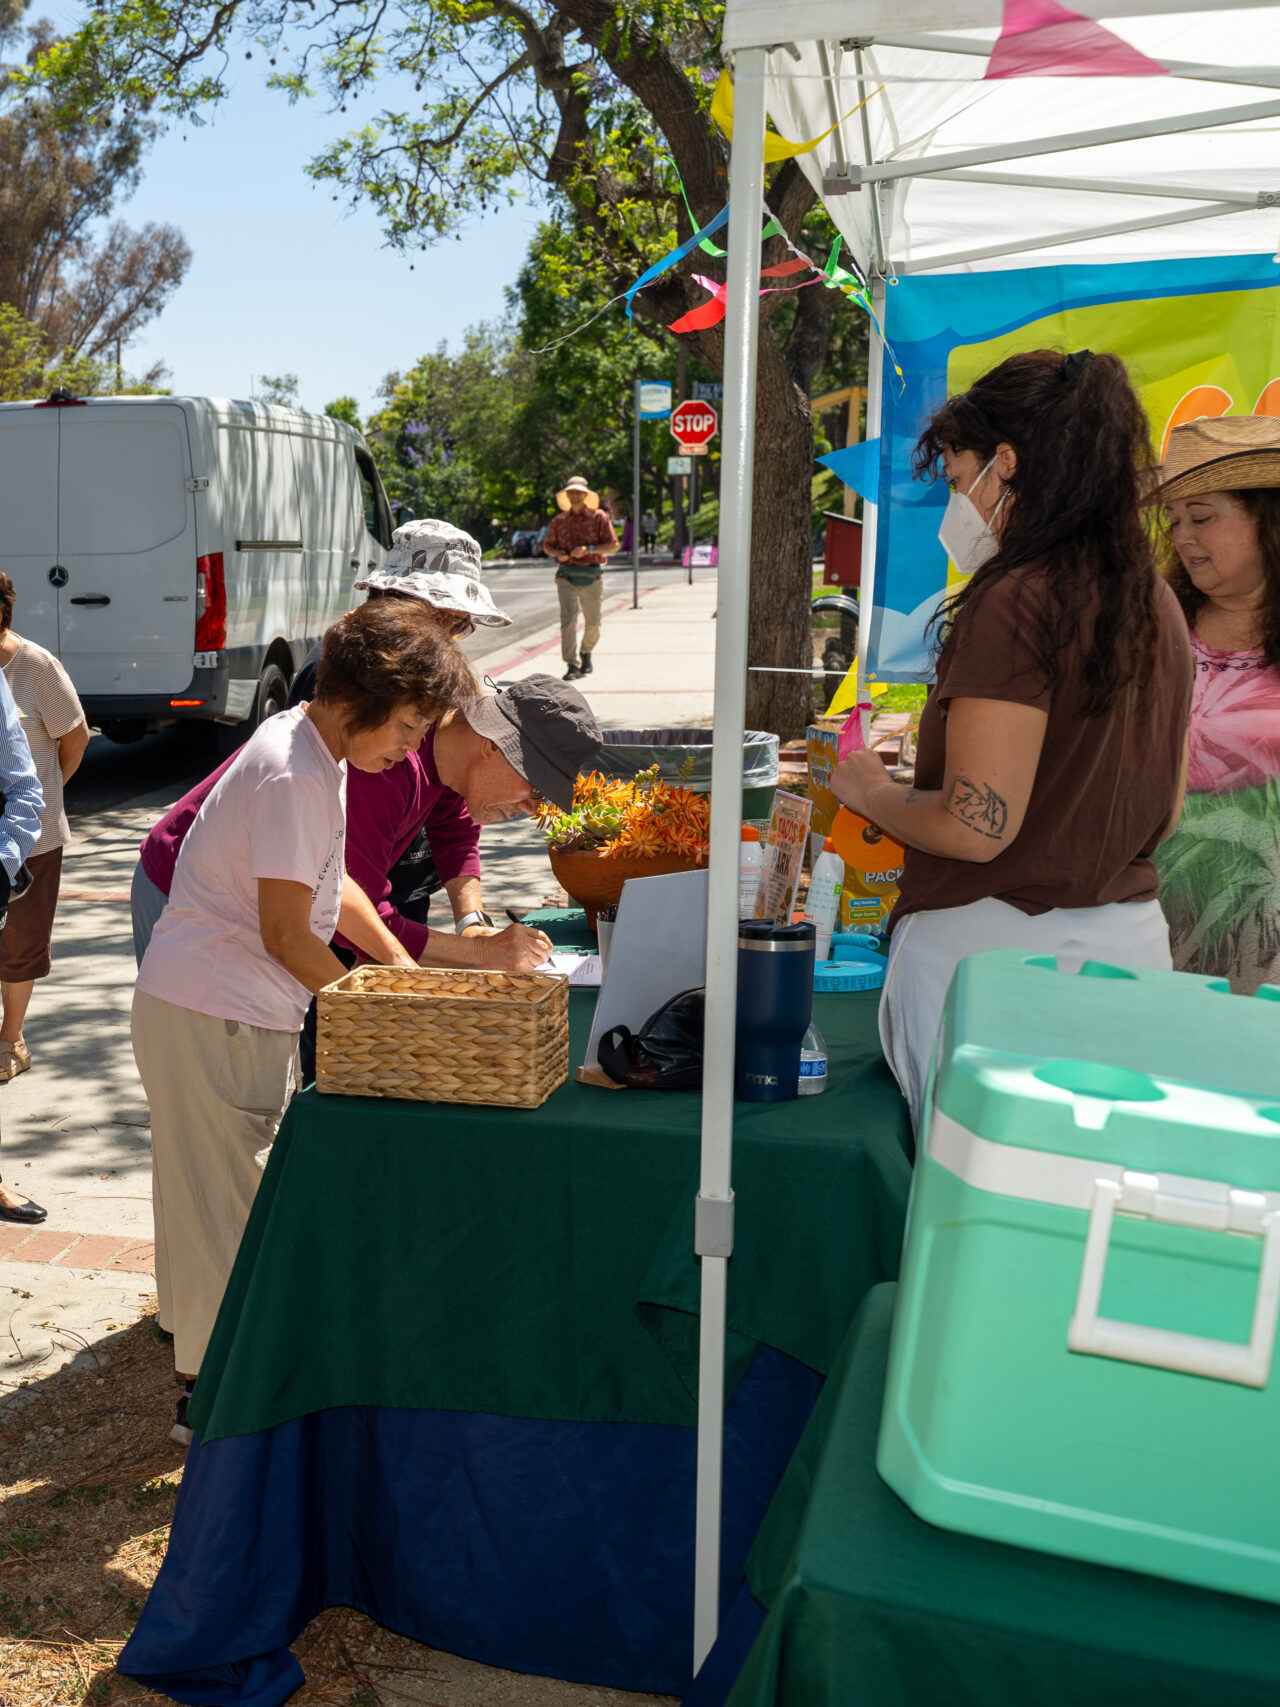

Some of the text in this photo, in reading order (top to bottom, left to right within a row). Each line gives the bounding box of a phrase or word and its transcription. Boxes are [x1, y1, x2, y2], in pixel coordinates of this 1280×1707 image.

[674, 414, 714, 432] STOP
[778, 817, 798, 844] TACOS
[770, 847, 792, 876] PARK
[311, 884, 321, 904] ake
